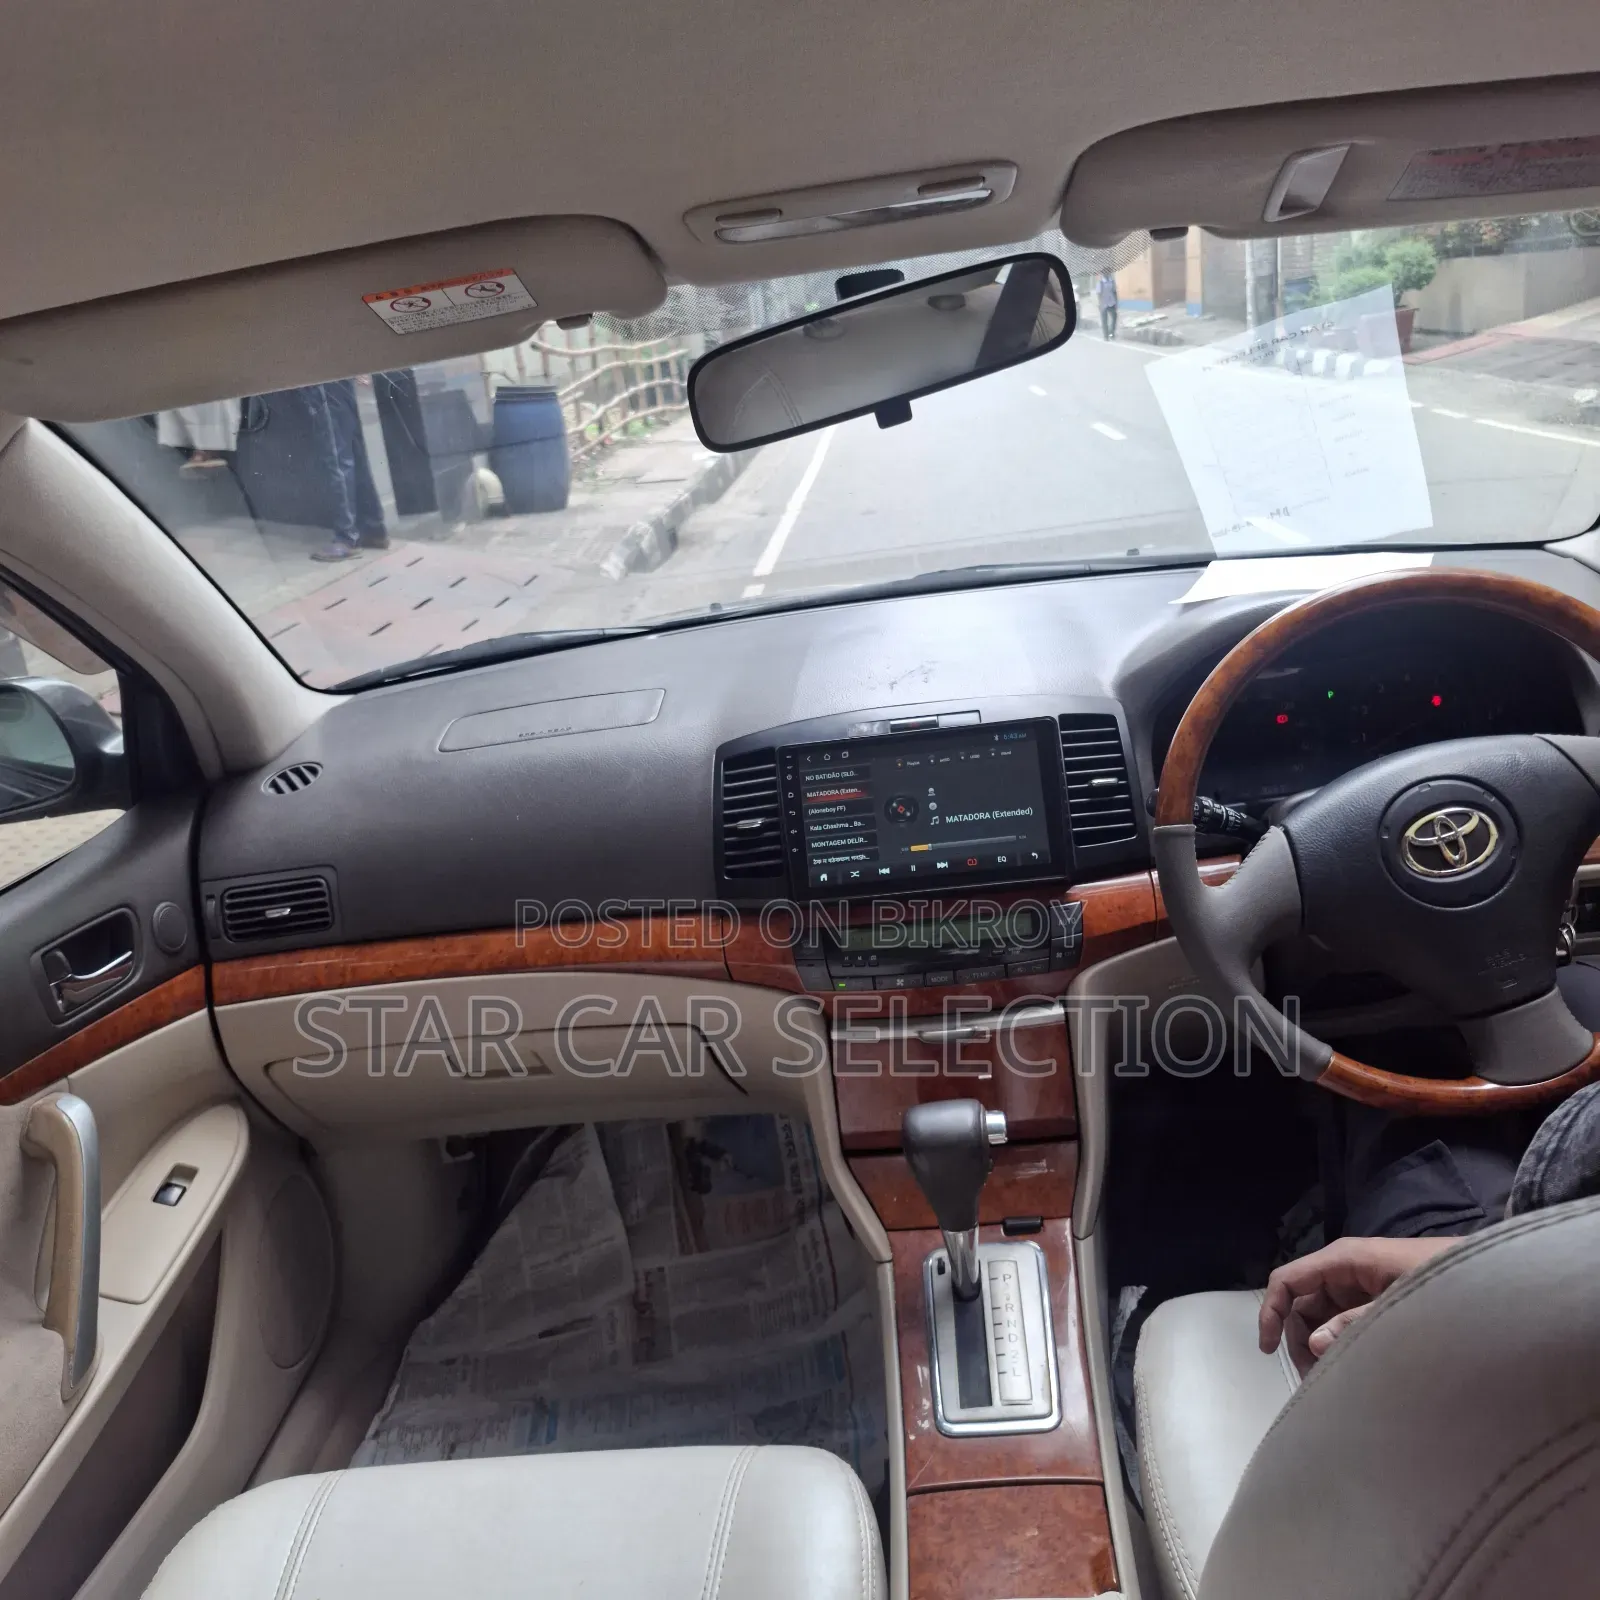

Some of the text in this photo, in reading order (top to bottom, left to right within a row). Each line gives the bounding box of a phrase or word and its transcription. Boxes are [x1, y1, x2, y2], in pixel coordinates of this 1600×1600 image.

[806, 789, 840, 798] MATADORA
[808, 806, 836, 815] (Aloneboy
[945, 807, 1033, 823] MATADORA (Extended)
[811, 839, 847, 848] MONTAGEM
[997, 855, 1007, 863] EQ
[1003, 1274, 1012, 1283] P
[1005, 1303, 1015, 1312] R
[1007, 1319, 1017, 1328] N
[1008, 1333, 1018, 1343] D
[1012, 1367, 1022, 1377] L
